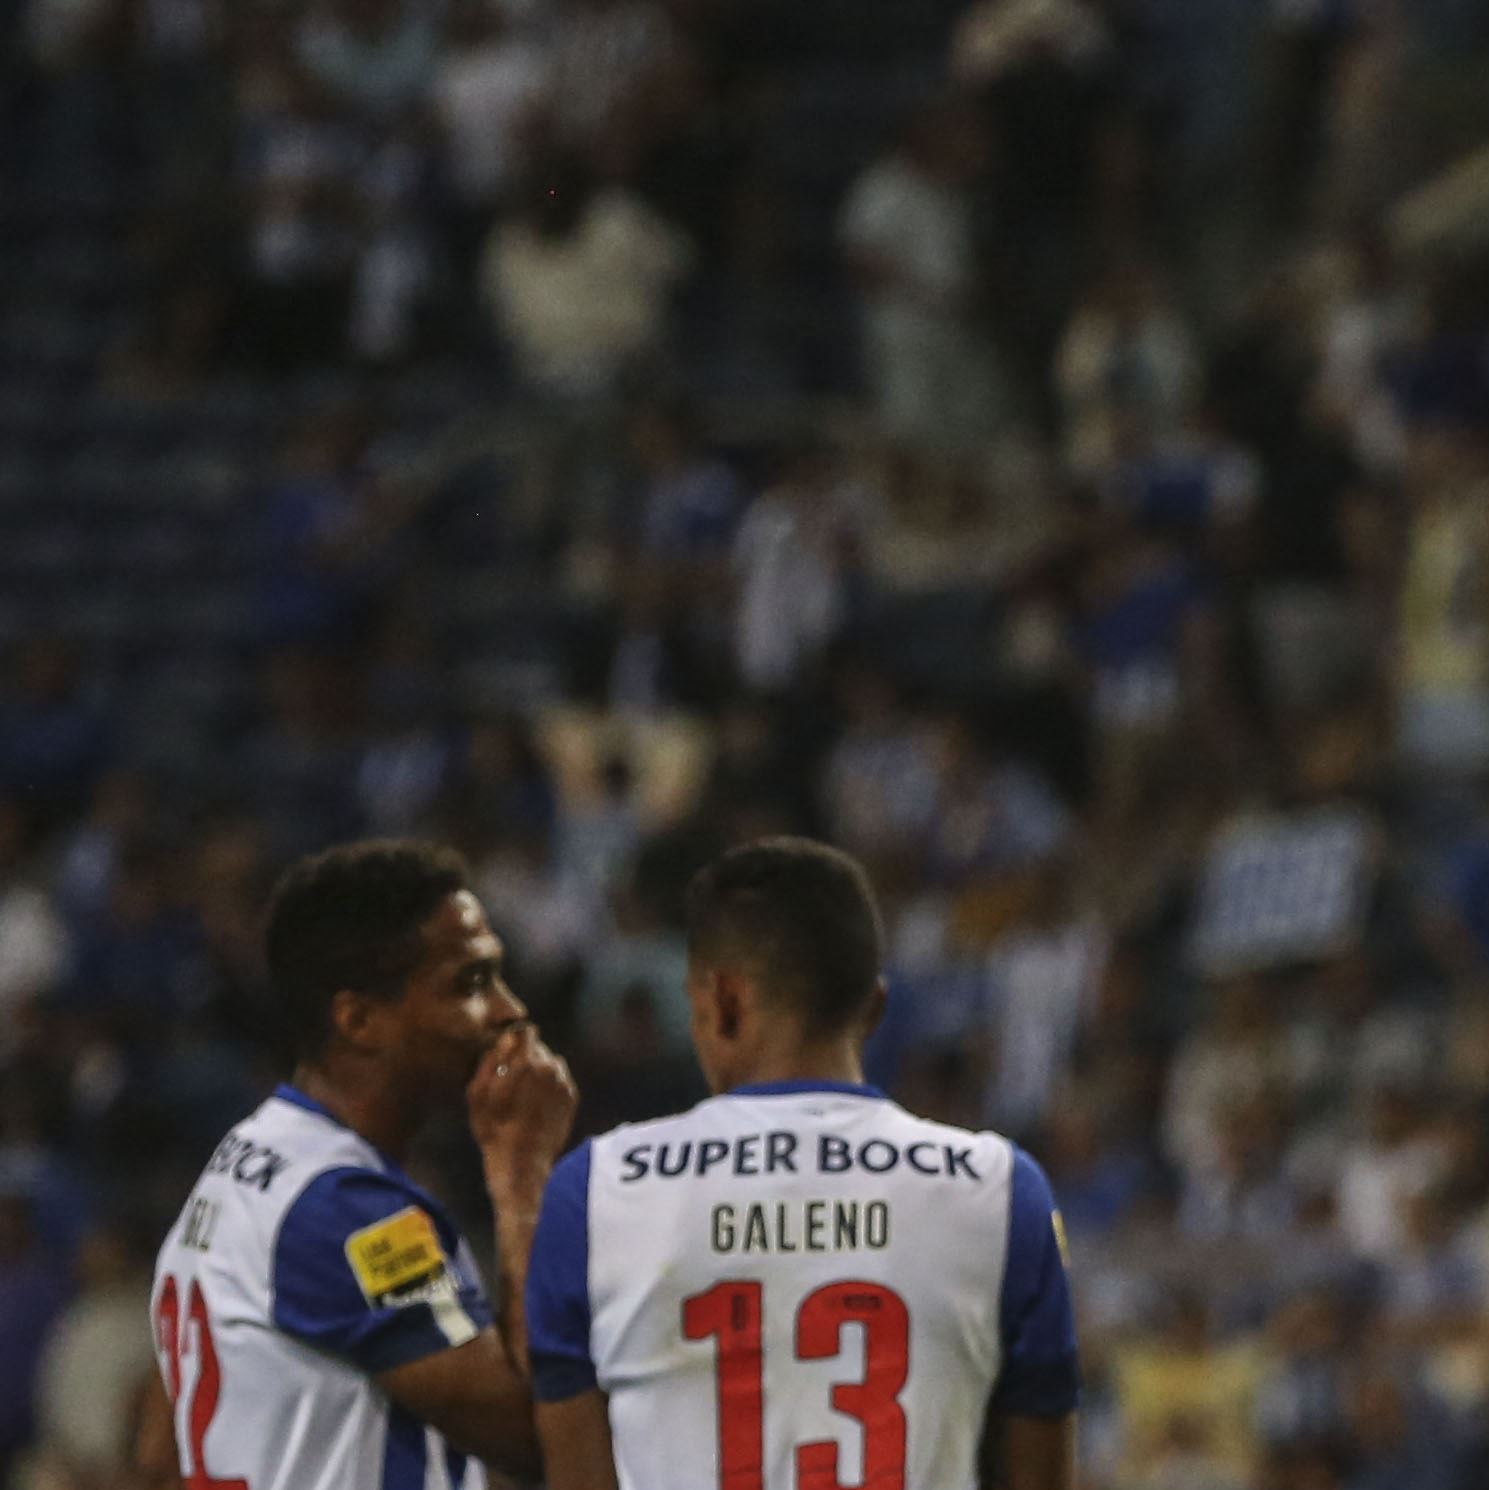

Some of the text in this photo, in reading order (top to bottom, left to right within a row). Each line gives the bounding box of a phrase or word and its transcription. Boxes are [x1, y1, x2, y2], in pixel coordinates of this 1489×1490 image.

[619, 1131, 982, 1182] SUPER BOCK
[711, 1201, 890, 1254] GALENO
